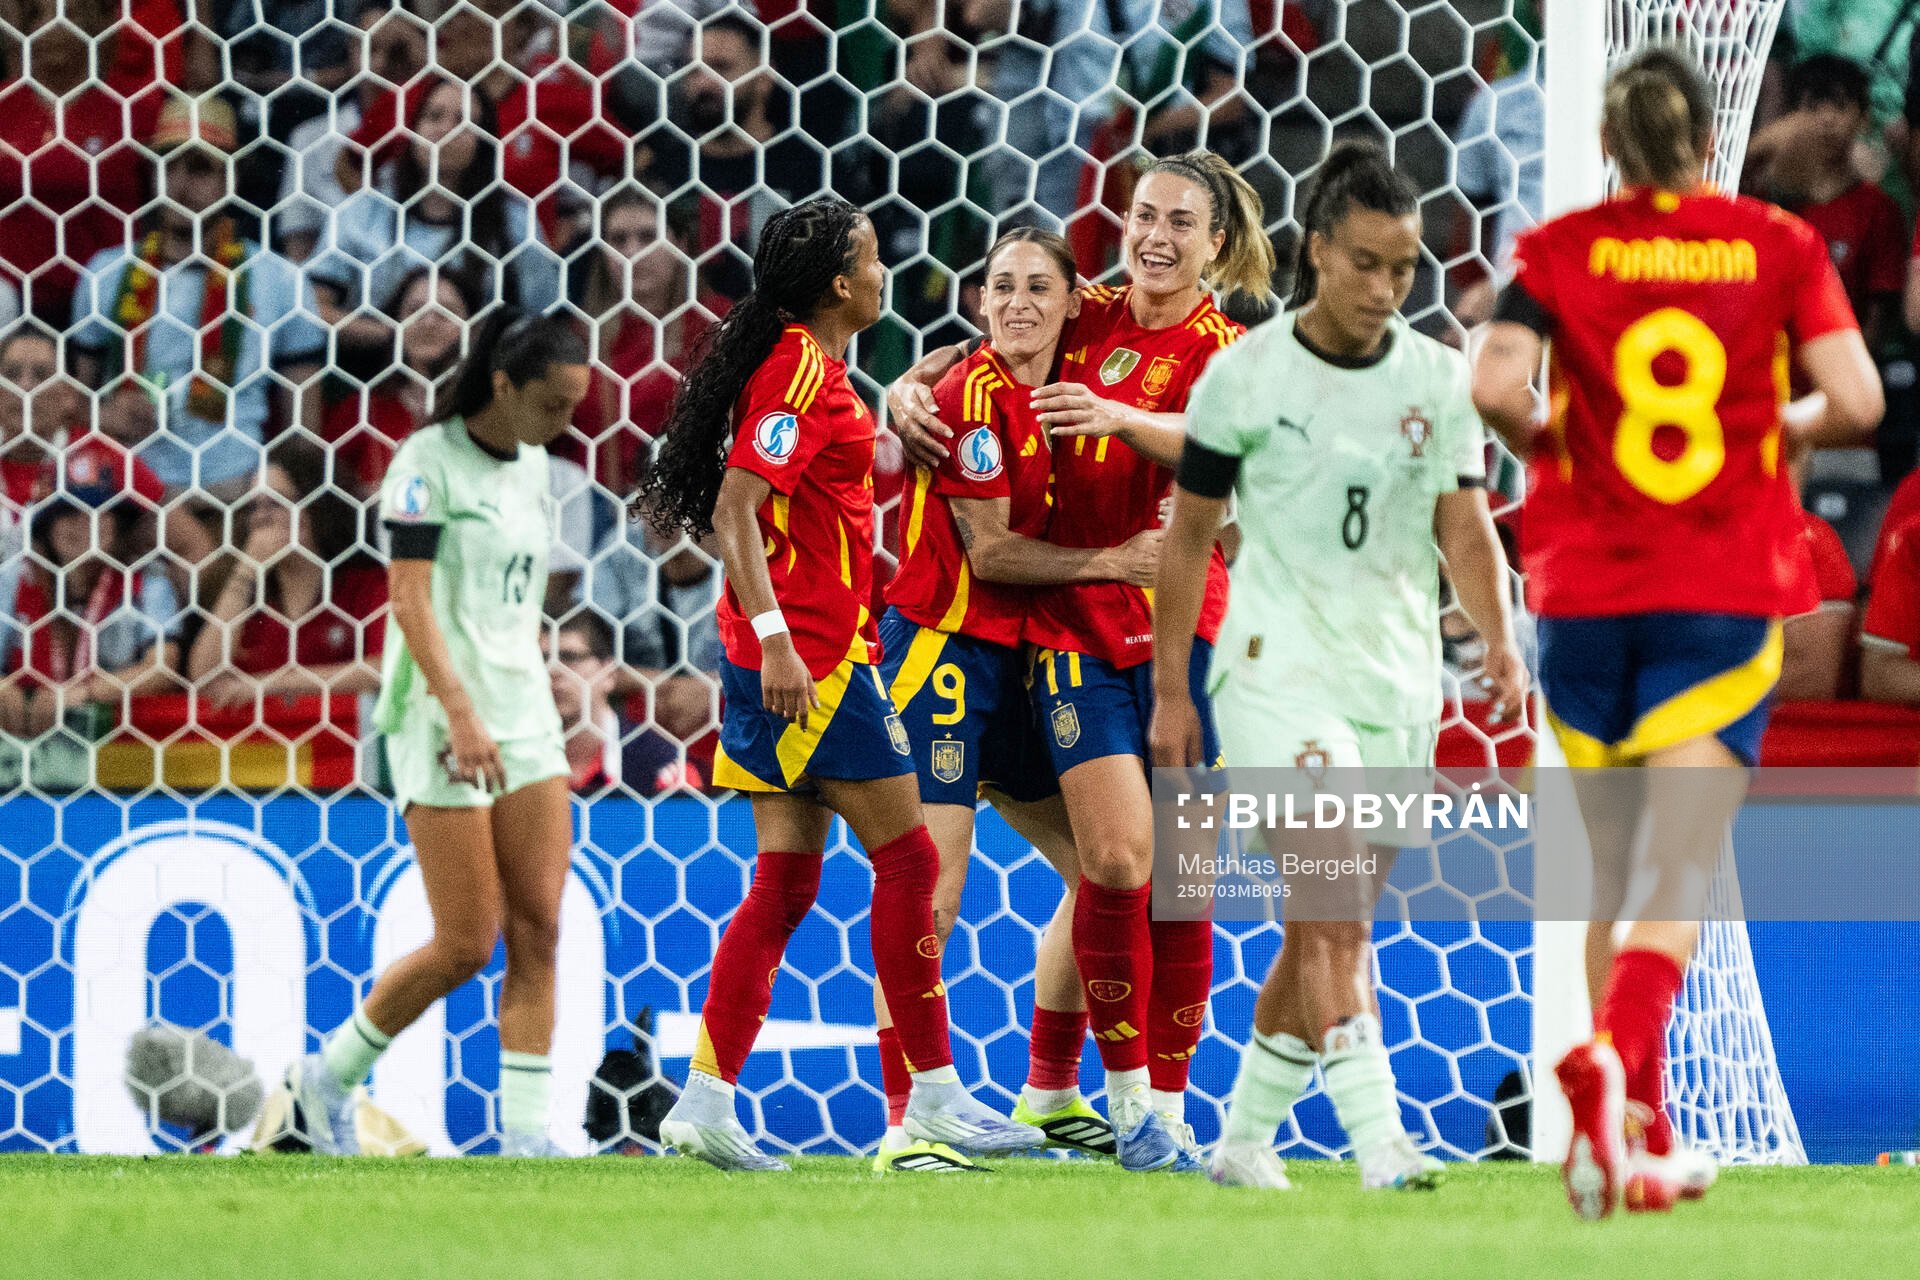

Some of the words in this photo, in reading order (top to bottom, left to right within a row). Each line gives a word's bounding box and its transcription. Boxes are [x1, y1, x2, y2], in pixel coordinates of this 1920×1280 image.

[1589, 236, 1757, 283] MARIONA
[1614, 306, 1727, 505] 8
[1342, 486, 1369, 550] 8
[932, 662, 966, 725] 9
[1038, 649, 1082, 695] 11
